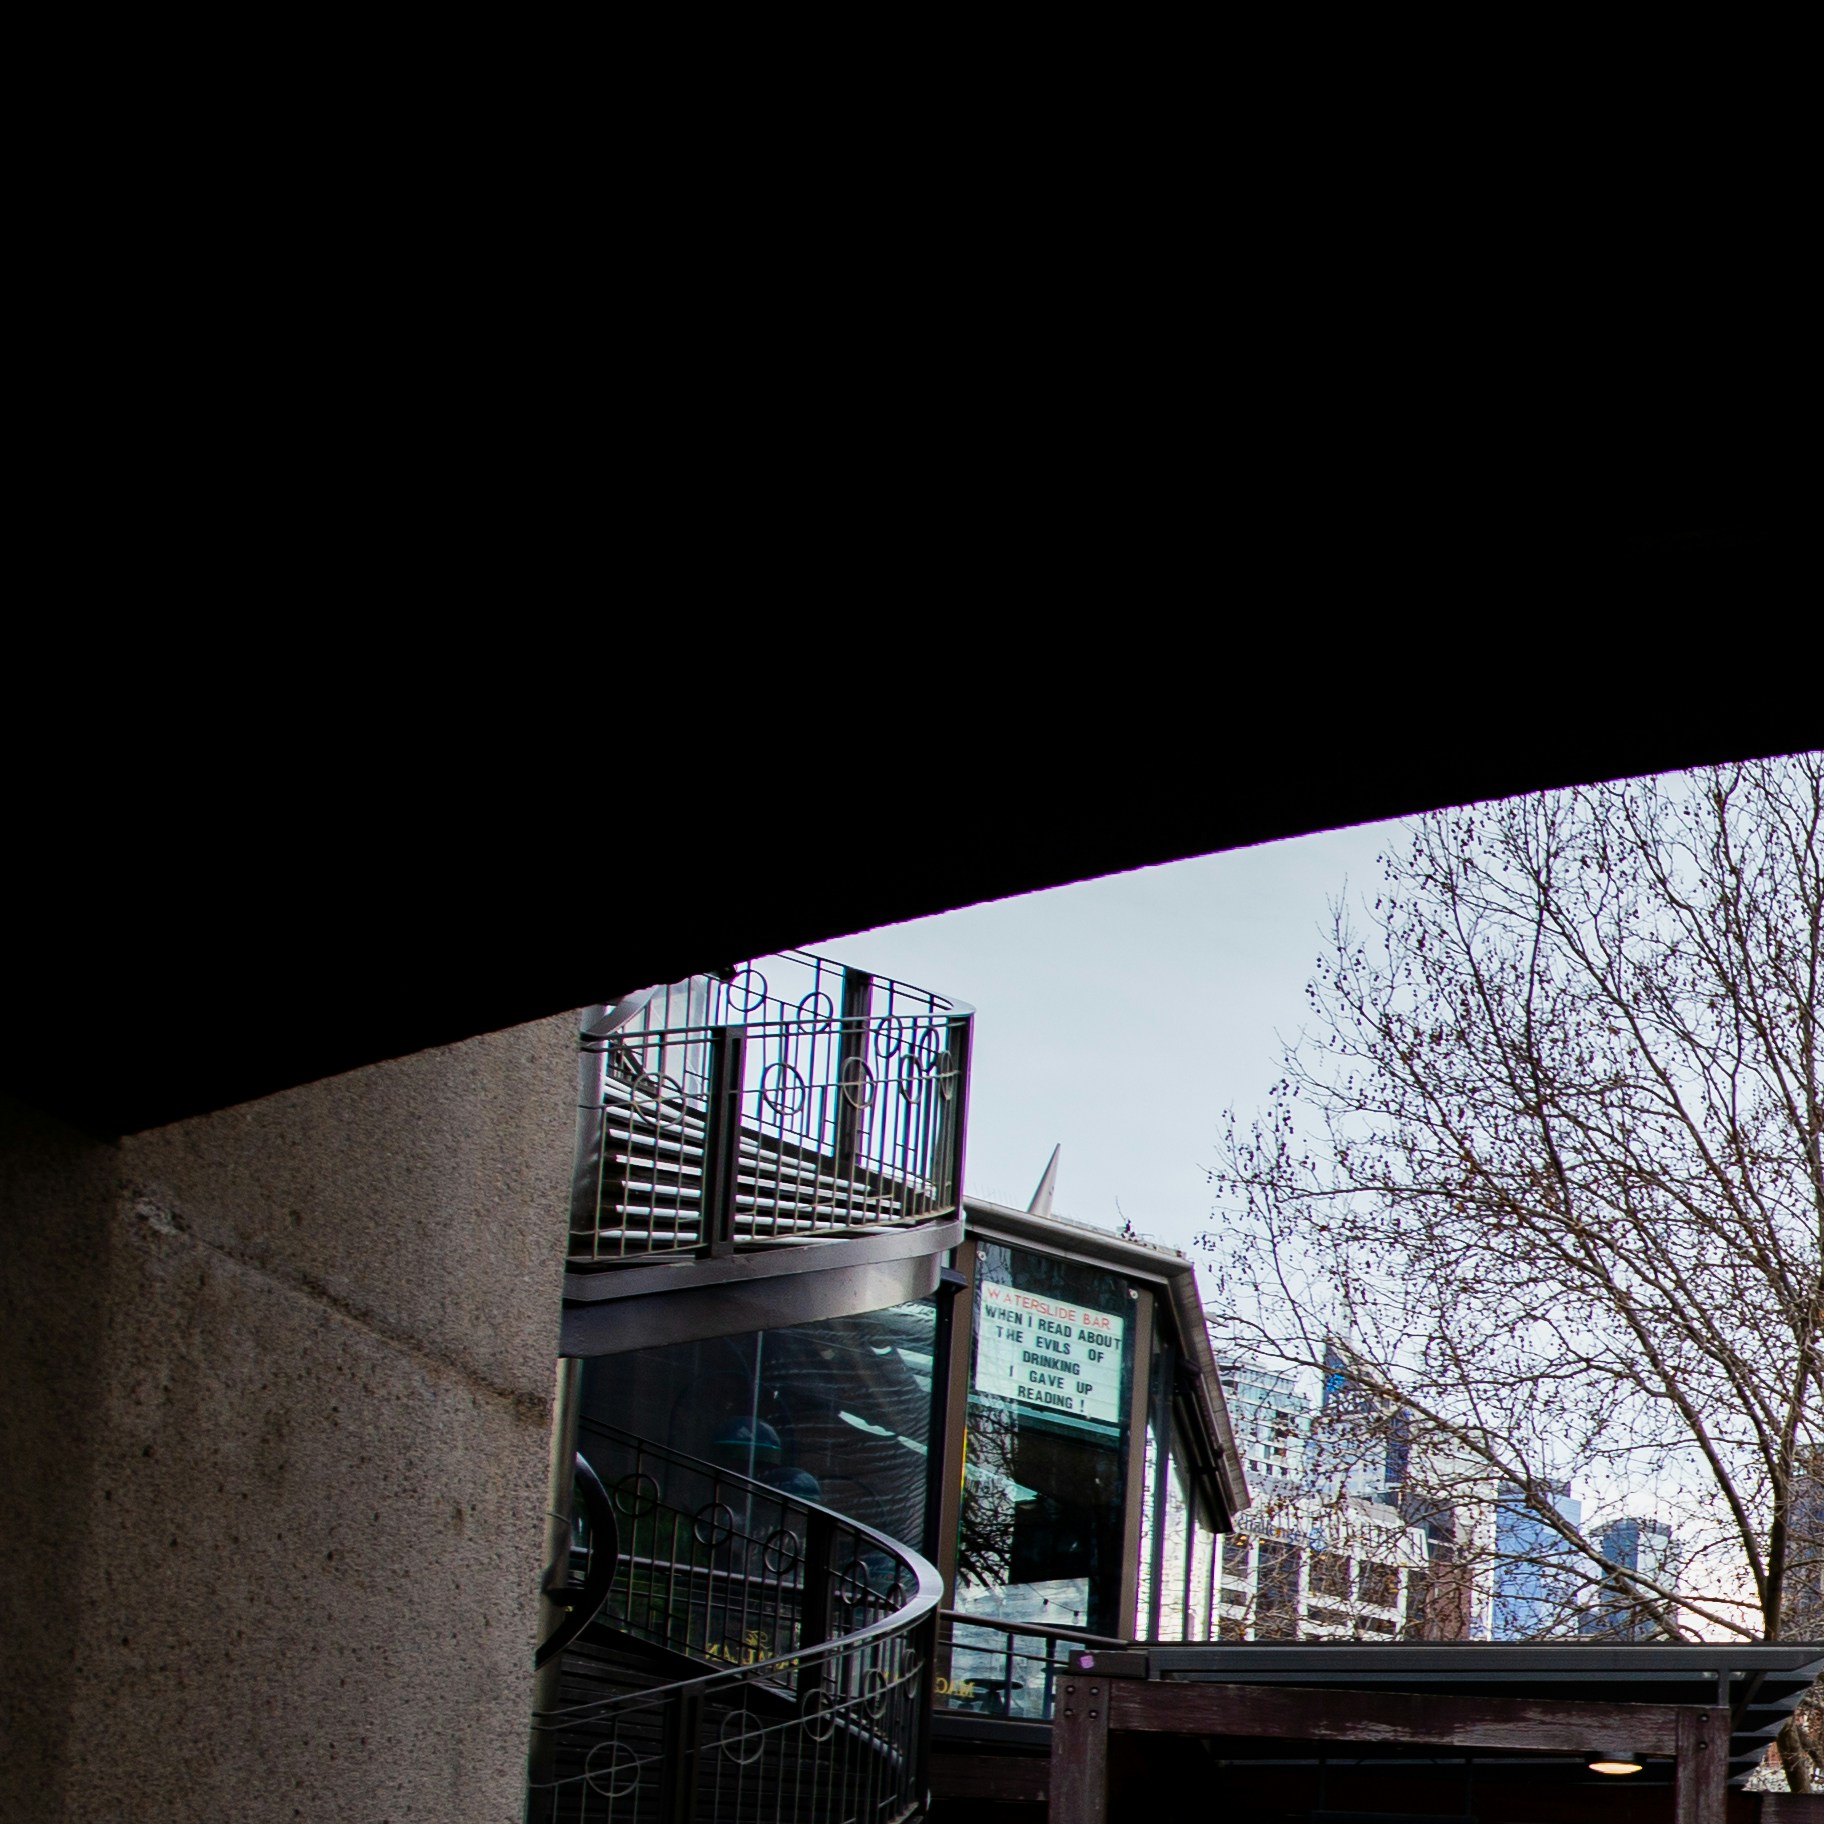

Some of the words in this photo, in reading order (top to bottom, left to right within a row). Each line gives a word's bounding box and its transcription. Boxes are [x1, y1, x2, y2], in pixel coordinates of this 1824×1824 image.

[987, 1288, 1077, 1322] WATERSLIDE
[1082, 1313, 1111, 1330] BAR
[984, 1305, 1023, 1325] WHEN
[1027, 1316, 1033, 1328] I
[1038, 1318, 1072, 1338] READ
[1077, 1329, 1122, 1350] ABOUT
[996, 1325, 1024, 1343] THE
[1035, 1335, 1071, 1355] EVILS
[1088, 1349, 1105, 1363] OF
[1022, 1350, 1081, 1375] DRINKING
[1009, 1365, 1014, 1377] I
[1029, 1370, 1065, 1390] GAVE
[1076, 1381, 1093, 1396] UP
[1017, 1385, 1074, 1410] READING
